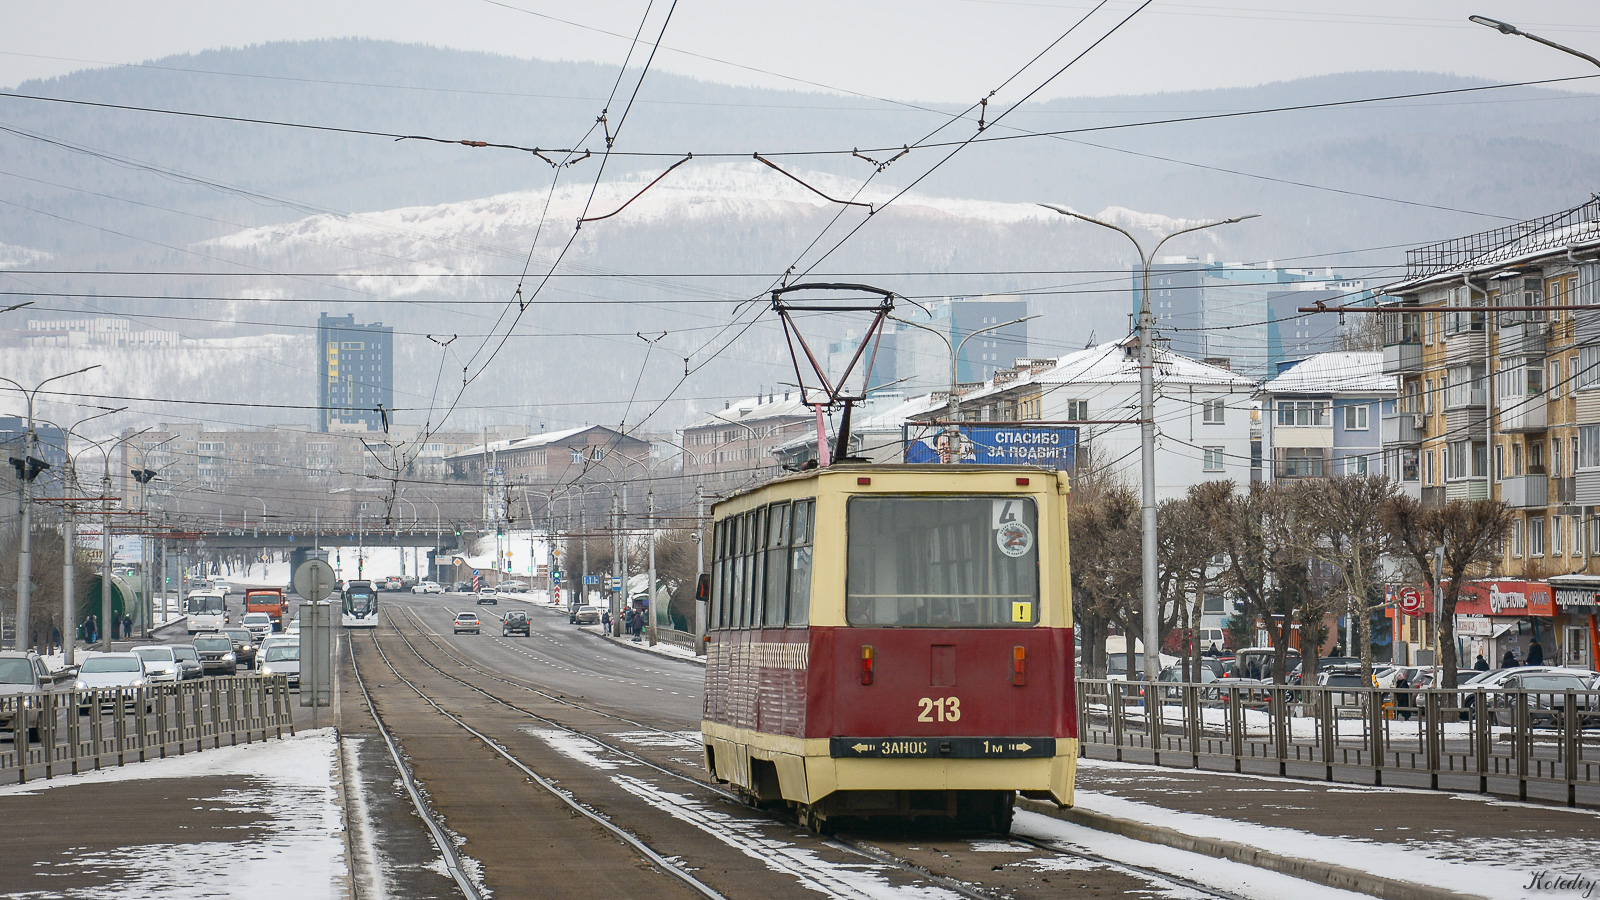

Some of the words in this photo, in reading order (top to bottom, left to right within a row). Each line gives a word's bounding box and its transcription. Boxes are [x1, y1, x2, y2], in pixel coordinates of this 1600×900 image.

[995, 431, 1059, 445] СПАСИБО
[987, 445, 1005, 458] ЗА
[1009, 446, 1067, 459] ПОДВИГ!
[999, 501, 1016, 524] 4
[1403, 591, 1417, 607] Б
[917, 696, 961, 723] 213
[881, 741, 927, 754] ЗАНОС
[983, 740, 990, 754] 1
